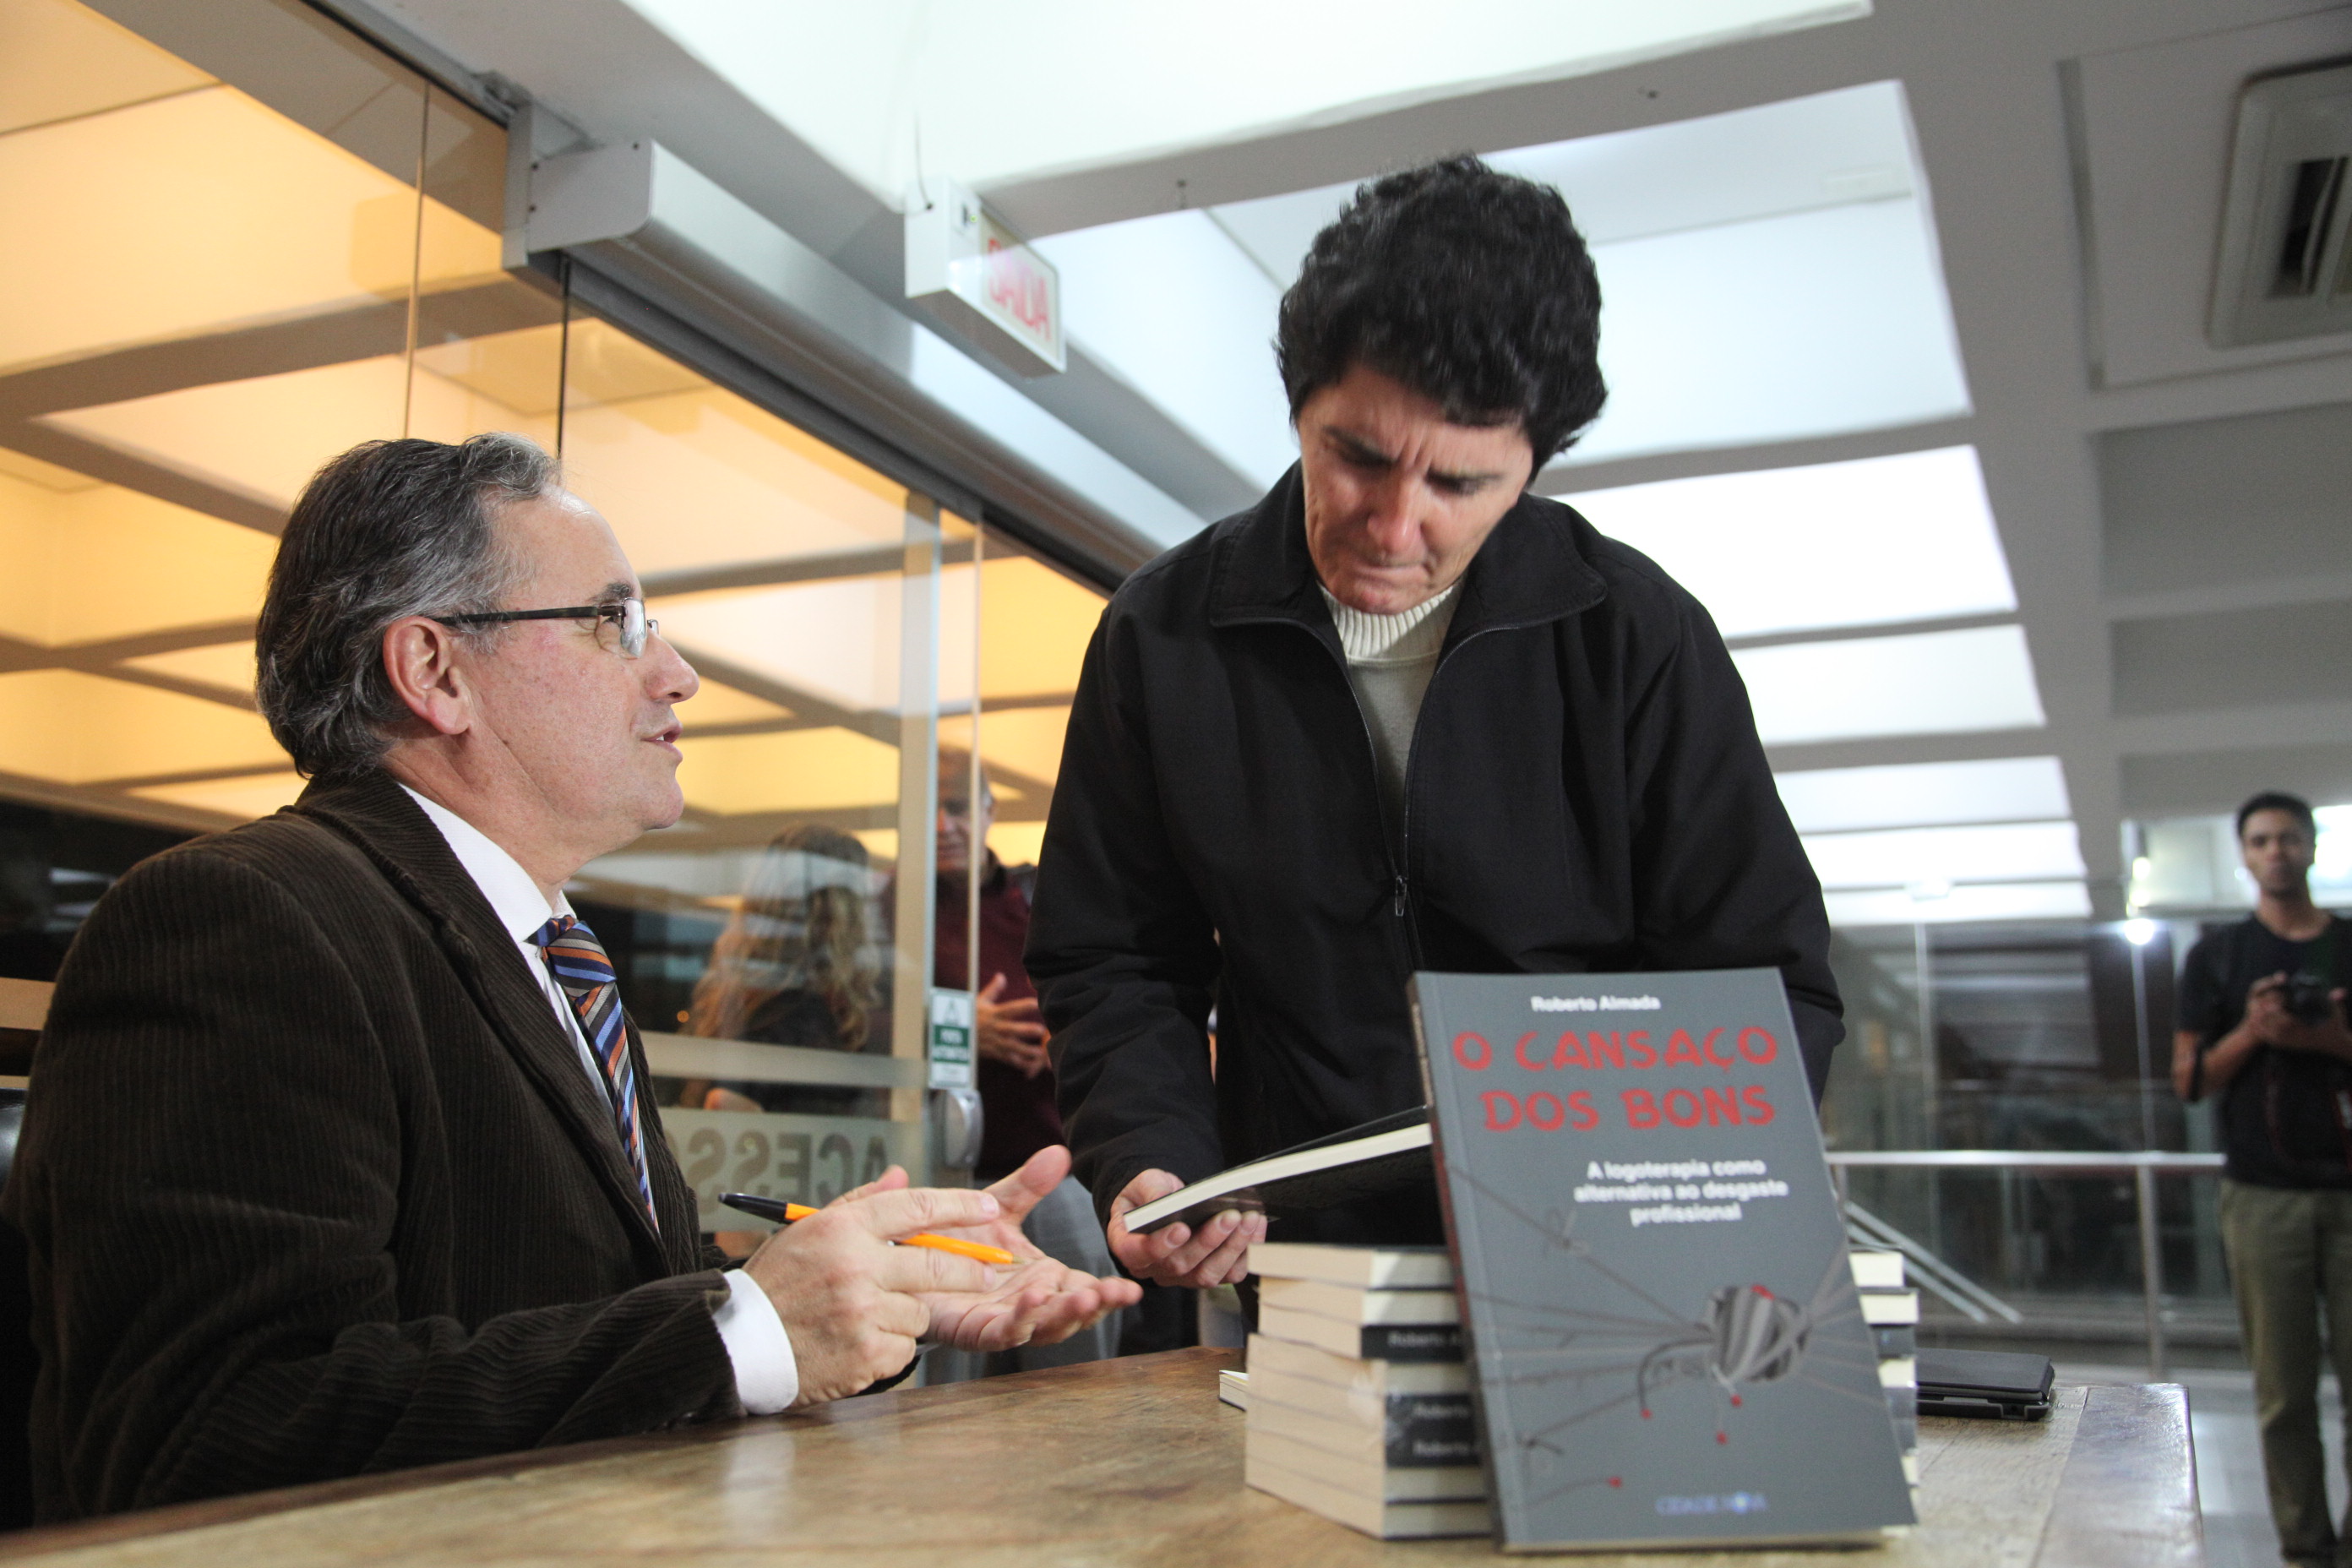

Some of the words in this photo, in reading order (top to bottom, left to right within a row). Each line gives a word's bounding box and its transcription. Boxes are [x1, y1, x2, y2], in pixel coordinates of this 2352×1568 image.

[1530, 995, 1598, 1012] Roberto
[1599, 994, 1662, 1011] Almada
[1452, 1030, 1494, 1072] O
[1514, 1026, 1778, 1074] CANSAÇO
[1480, 1090, 1600, 1133] DOS
[1620, 1084, 1776, 1130] BONS
[1587, 1161, 1604, 1180] A
[1603, 1159, 1711, 1183] logoterapia
[1712, 1159, 1767, 1177] como
[1573, 1183, 1674, 1203] alternativa
[1674, 1184, 1701, 1200] ao
[1701, 1179, 1789, 1202] desgaste
[1629, 1200, 1743, 1228] profissional
